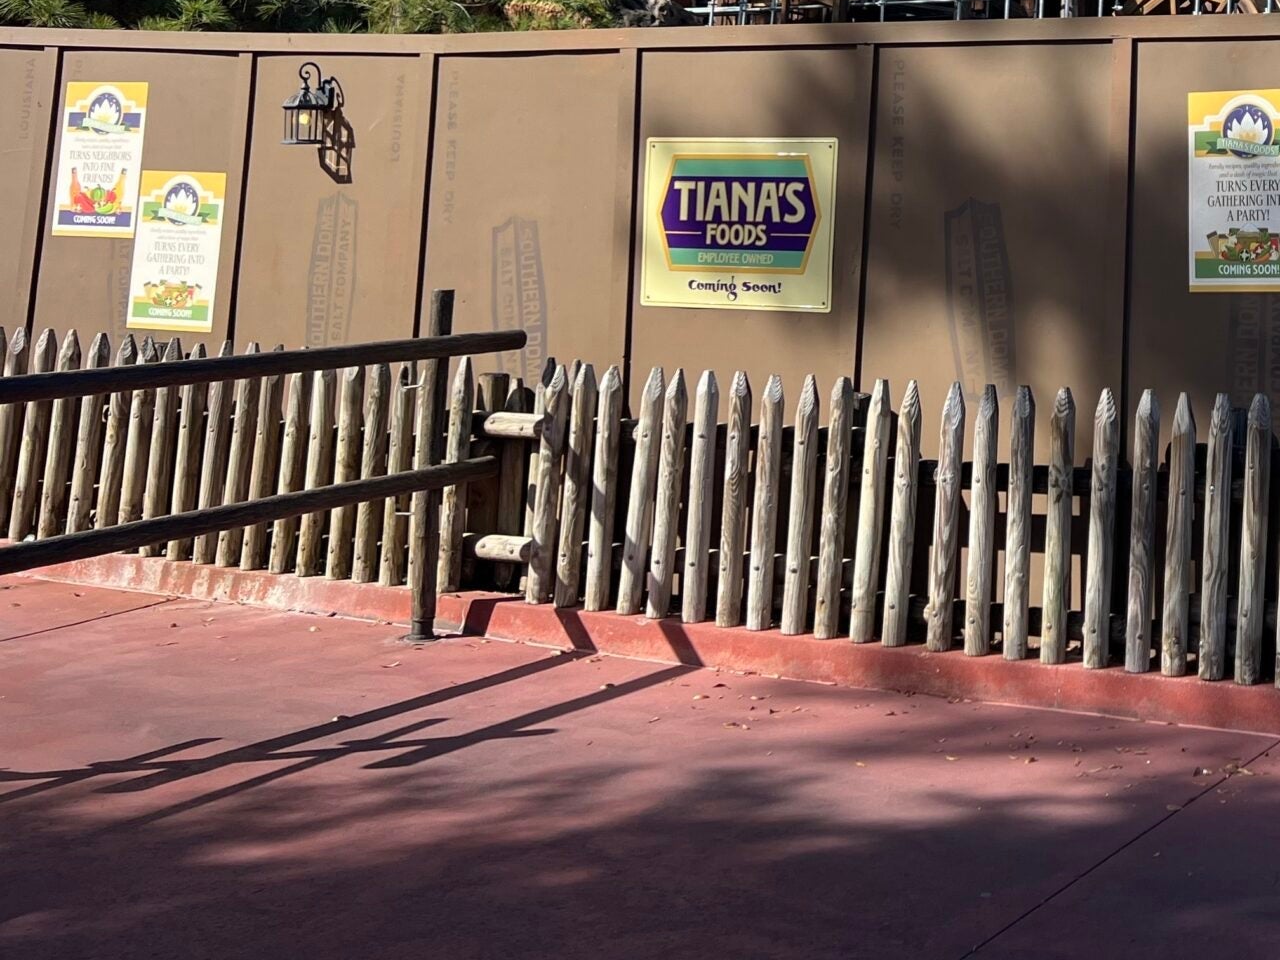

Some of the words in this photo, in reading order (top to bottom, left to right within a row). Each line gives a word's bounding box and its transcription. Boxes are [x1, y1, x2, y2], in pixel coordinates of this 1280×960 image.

[18, 57, 37, 139] LOUISIANA
[891, 59, 905, 126] PLEASE
[389, 74, 406, 162] LOUISIANA
[889, 135, 905, 182] KEEP
[673, 180, 807, 224] TIANA'S
[1207, 194, 1264, 208] GATHERING
[1215, 180, 1248, 193] TURNS
[1250, 179, 1280, 192] EVERY
[887, 192, 903, 231] DRY
[1226, 209, 1234, 222] A
[1236, 209, 1271, 222] PARTY!
[705, 223, 768, 246] FOODS
[335, 218, 352, 298] COMPANY
[520, 227, 542, 327] SOUTHERN
[697, 252, 740, 264] EMPLOYEE
[742, 253, 774, 265] OWNED
[1218, 264, 1251, 275] COMING
[1252, 264, 1280, 275] SOON!
[310, 261, 331, 346] OUTHERN
[688, 276, 738, 302] Coming
[741, 281, 782, 294] Soon!
[330, 303, 345, 341] SALT
